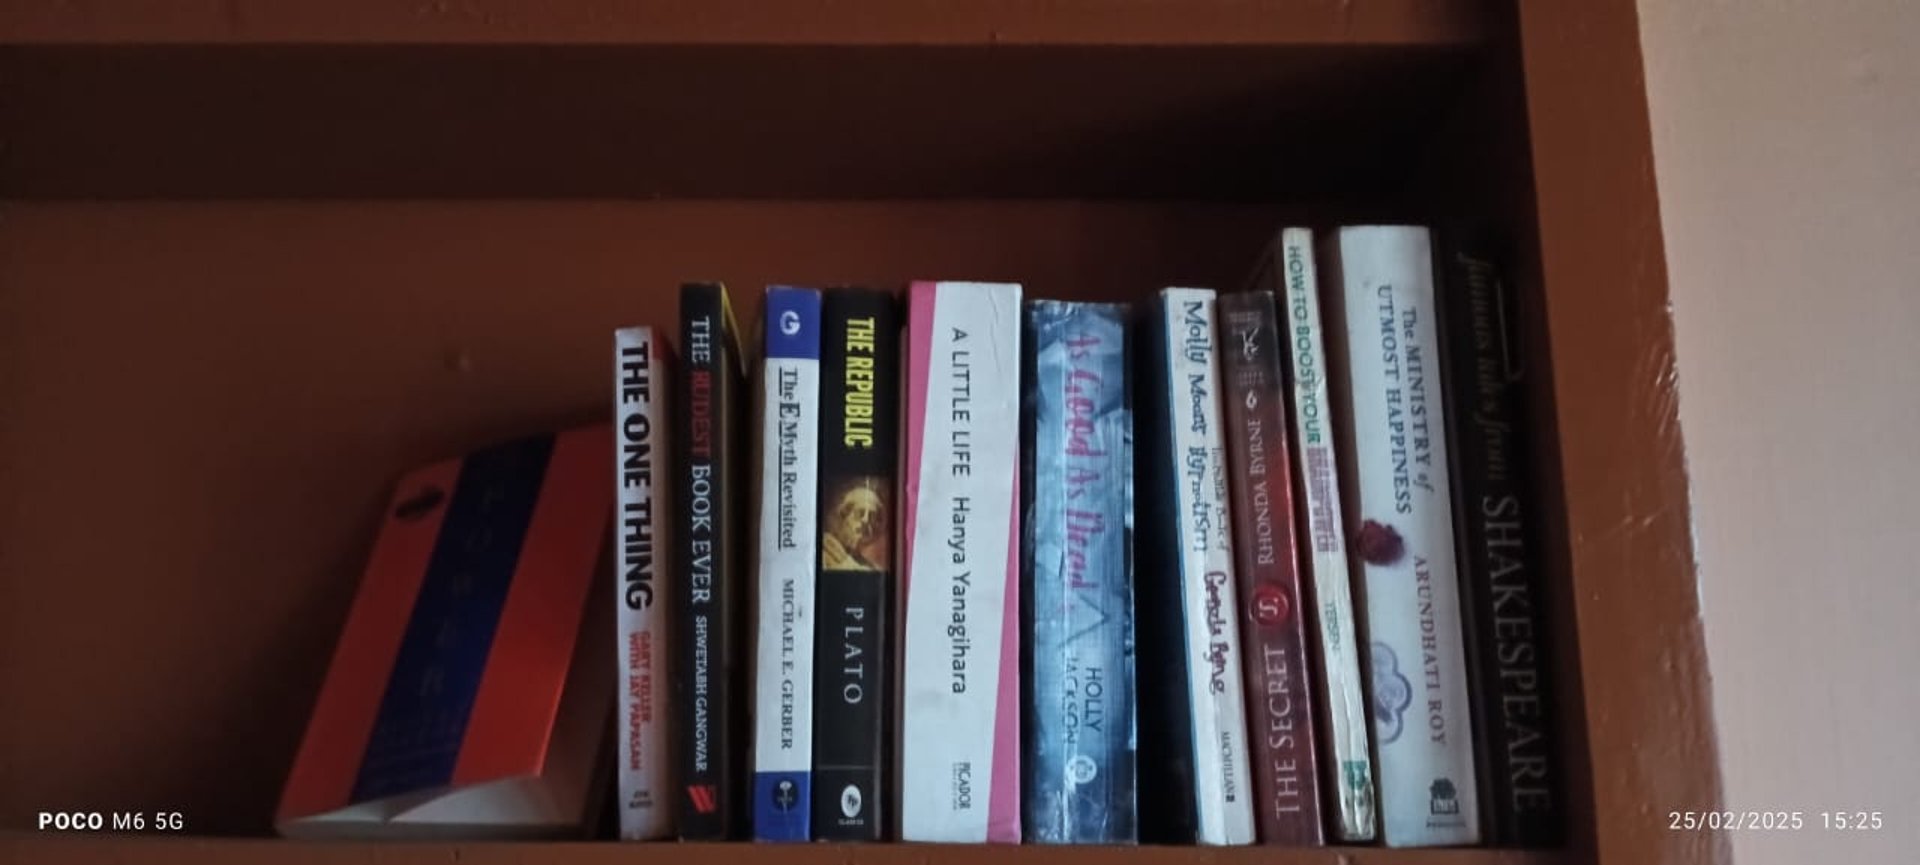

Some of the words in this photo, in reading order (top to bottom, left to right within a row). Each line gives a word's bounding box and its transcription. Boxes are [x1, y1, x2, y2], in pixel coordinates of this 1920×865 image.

[1289, 246, 1305, 289] HOW
[691, 315, 711, 363] THE
[846, 317, 876, 353] THE
[952, 327, 968, 342] A
[1183, 301, 1212, 364] Molly
[1294, 295, 1308, 321] TO
[1377, 284, 1400, 380] UTMOST
[1403, 307, 1416, 339] The
[622, 341, 651, 403] THE
[783, 368, 798, 398] The
[952, 352, 970, 421] LITTLE
[1296, 326, 1316, 389] BOOST
[690, 369, 712, 457] RUDEST
[844, 356, 875, 448] REPUBLIC
[1301, 391, 1321, 443] YOUR
[1406, 345, 1430, 465] MINISTRY
[624, 413, 652, 489] ONE
[781, 420, 798, 466] Myth
[952, 431, 970, 477] LIFE
[1247, 419, 1266, 475] BYRNE
[1386, 389, 1412, 514] HAPPINESS
[691, 464, 712, 531] BOOK
[782, 472, 798, 549] Revisited
[948, 497, 970, 564] Hanya
[1253, 481, 1275, 565] RHONDA
[625, 497, 653, 611] THING
[691, 539, 712, 603] EVER
[783, 579, 795, 657] MICHAEL
[948, 571, 970, 694] Yanagihara
[1414, 556, 1440, 690] ARUNDHATI
[1427, 699, 1447, 746] ROY
[843, 607, 864, 704] PLATO
[1482, 495, 1551, 812] SHAKESPEARE
[781, 680, 794, 750] GERBER
[1085, 667, 1103, 732] HOLLY
[1264, 644, 1295, 751] SECRET
[957, 762, 971, 809] PICADOR
[1275, 758, 1301, 821] THE
